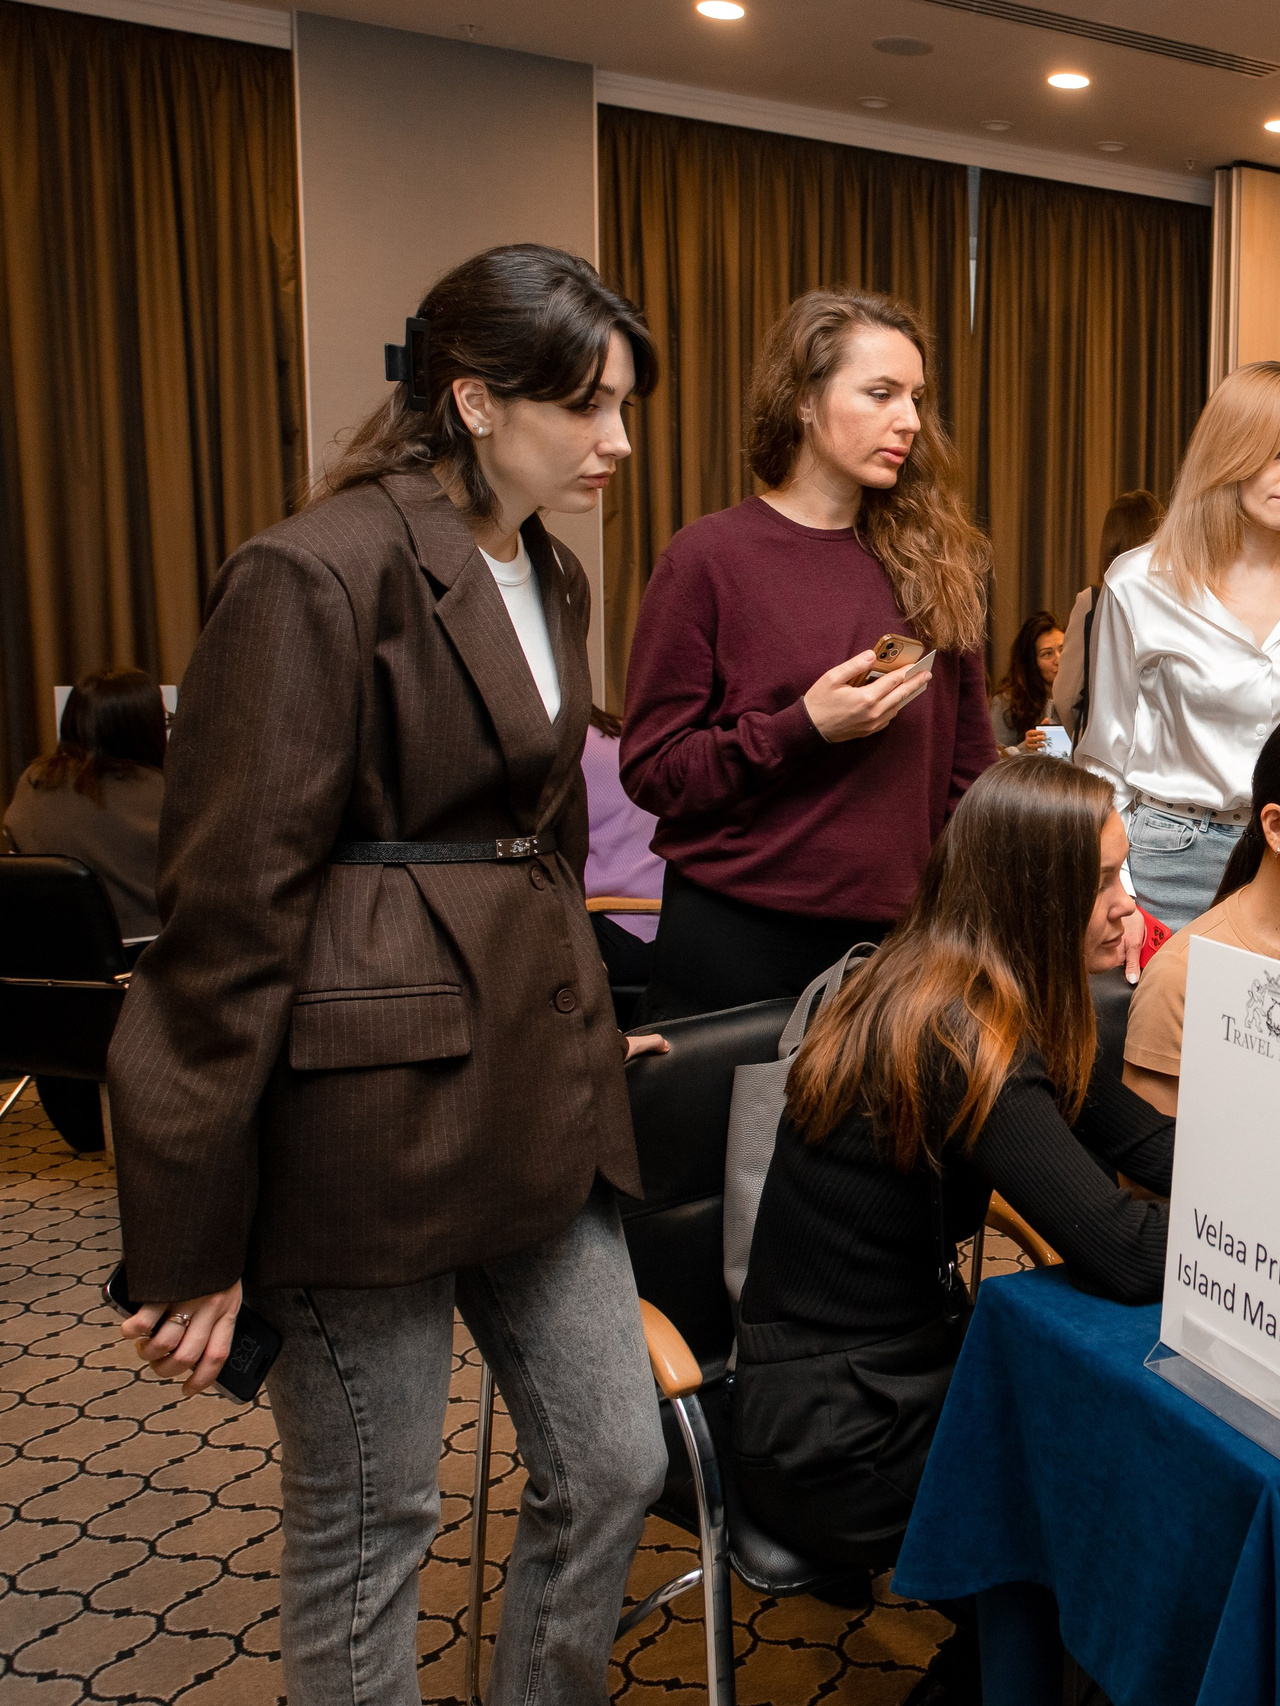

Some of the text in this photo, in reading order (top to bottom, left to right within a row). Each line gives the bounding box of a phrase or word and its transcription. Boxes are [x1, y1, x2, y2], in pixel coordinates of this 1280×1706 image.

[1222, 1014, 1274, 1059] TRAVEL
[1194, 1208, 1247, 1265] Velaa
[1178, 1253, 1236, 1313] Island
